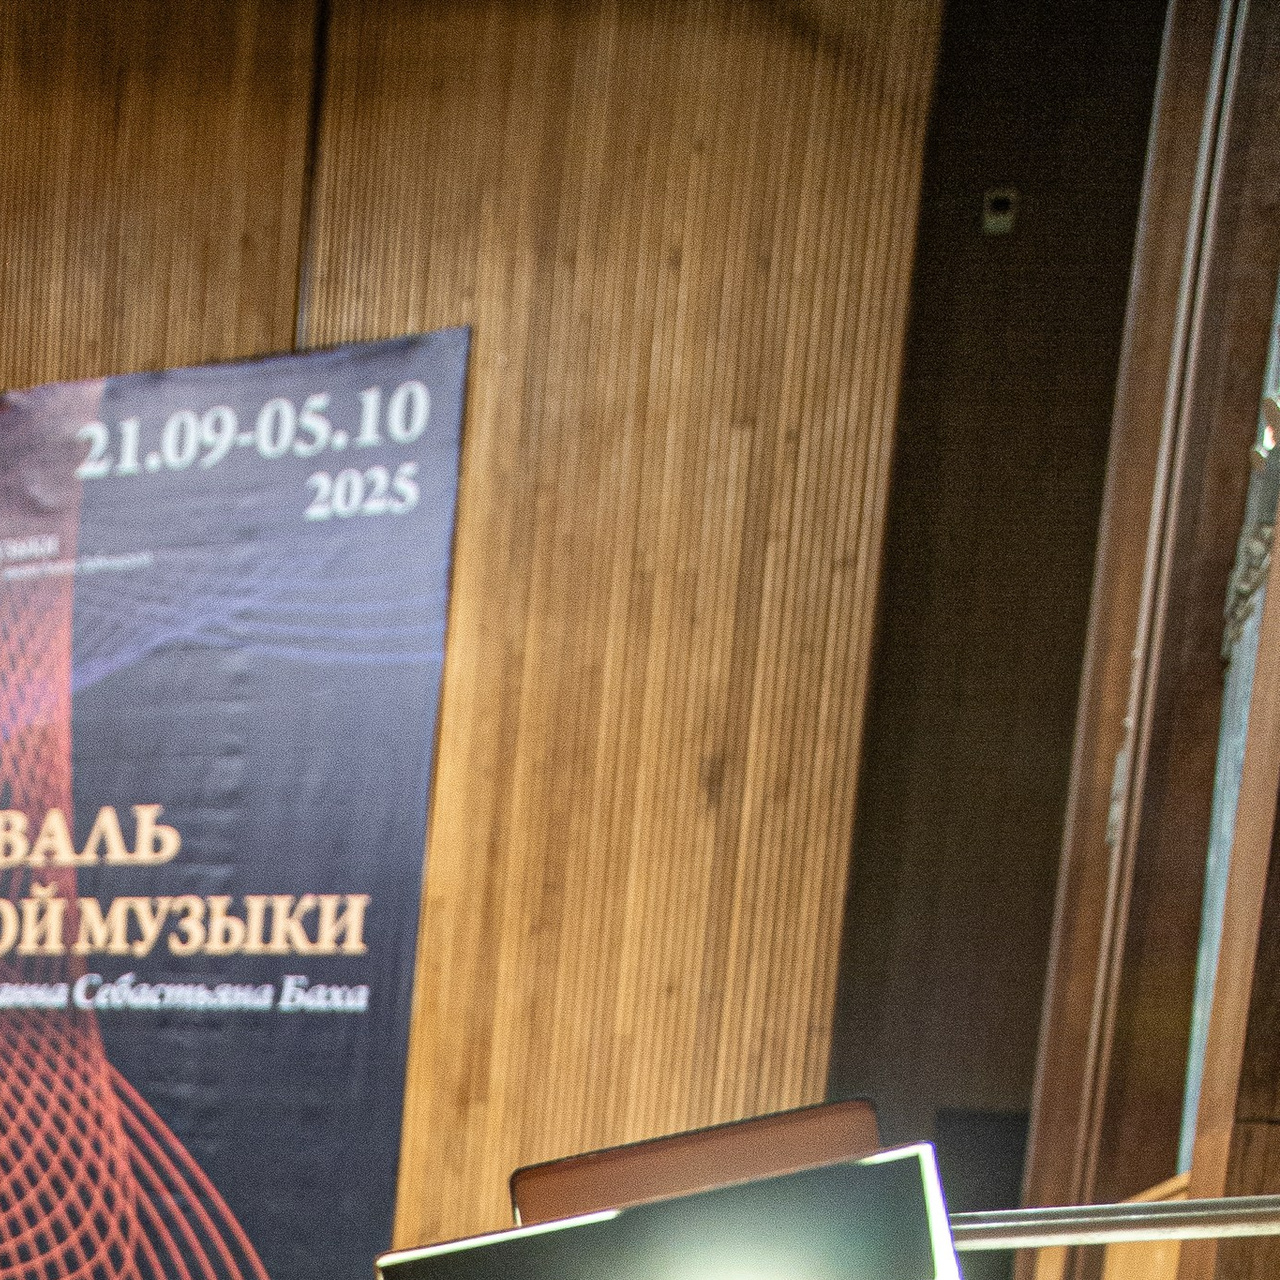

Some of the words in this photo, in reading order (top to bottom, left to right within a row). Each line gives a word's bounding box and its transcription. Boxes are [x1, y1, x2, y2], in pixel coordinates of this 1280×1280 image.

[75, 380, 431, 480] 21.09-05.10
[303, 461, 420, 522] 2025
[73, 893, 371, 957] МУЗЫКИ
[73, 972, 275, 1012] Себастьяна
[278, 974, 370, 1014] Баха
